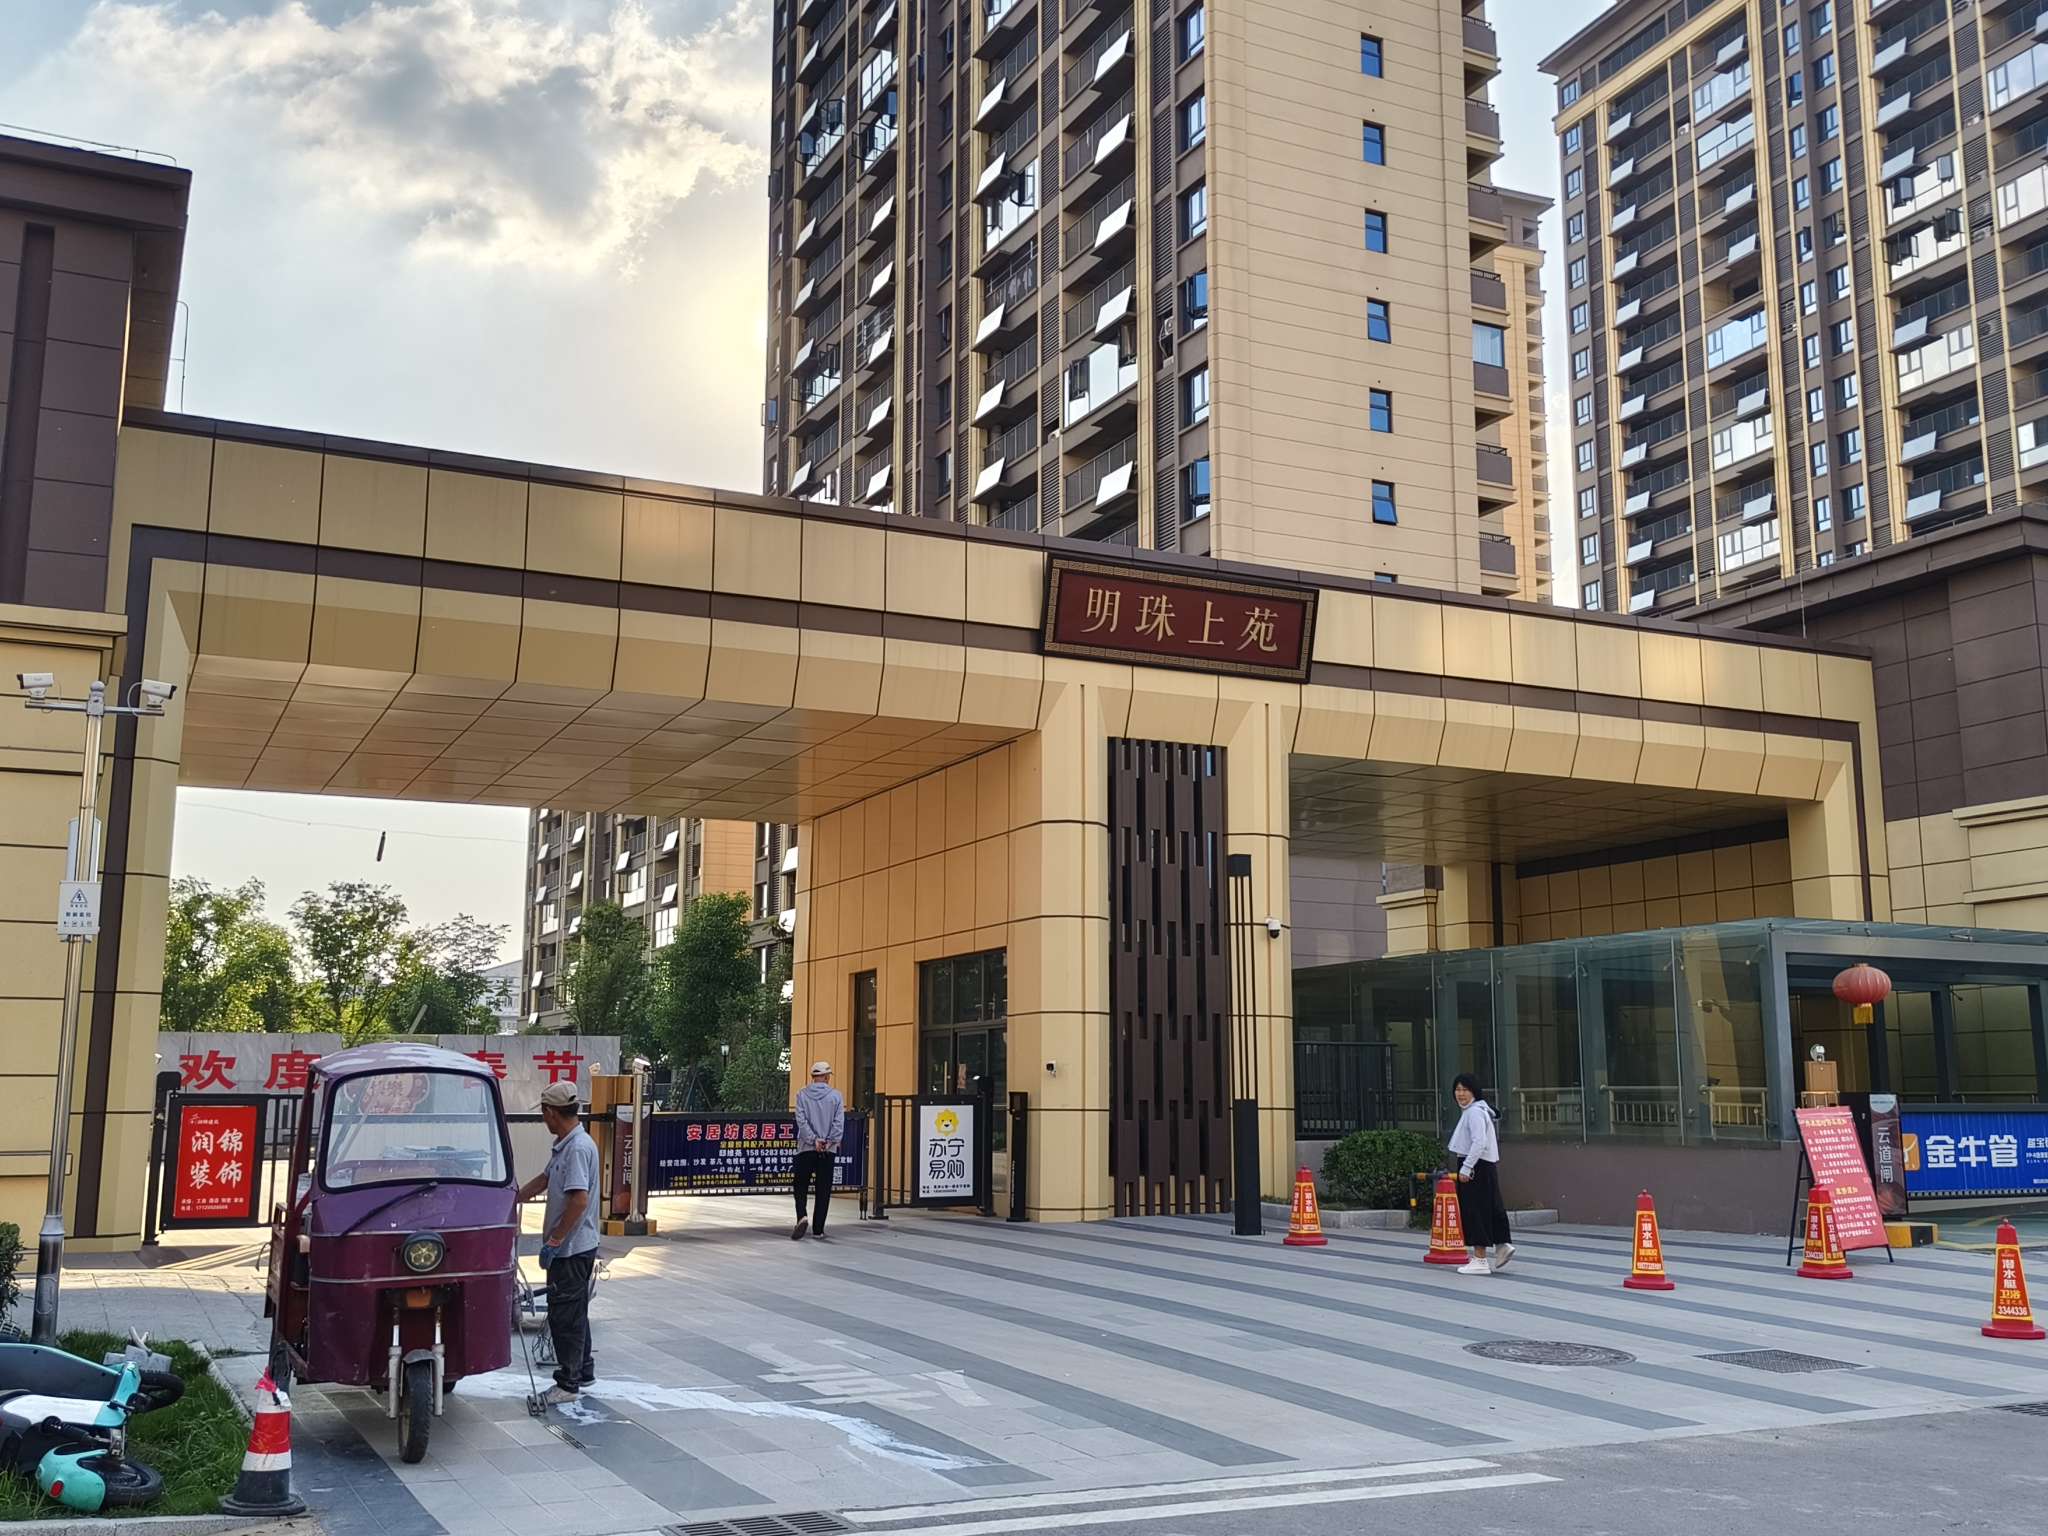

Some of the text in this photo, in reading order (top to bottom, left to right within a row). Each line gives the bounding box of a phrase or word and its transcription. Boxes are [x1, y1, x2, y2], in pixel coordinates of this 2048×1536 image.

[1080, 588, 1279, 652] 明珠上苑
[687, 1124, 794, 1141] 安居坊家居工
[929, 1138, 965, 1158] 苏宁
[1878, 1127, 1893, 1183] 云道闸
[1926, 1135, 2018, 1168] 金牛管
[190, 1159, 242, 1189] 装饰
[929, 1160, 965, 1179] 易购
[2002, 1259, 2017, 1289] 潜水艇
[2000, 1290, 2021, 1299] 卫浴
[1998, 1305, 2028, 1316] 3344336
